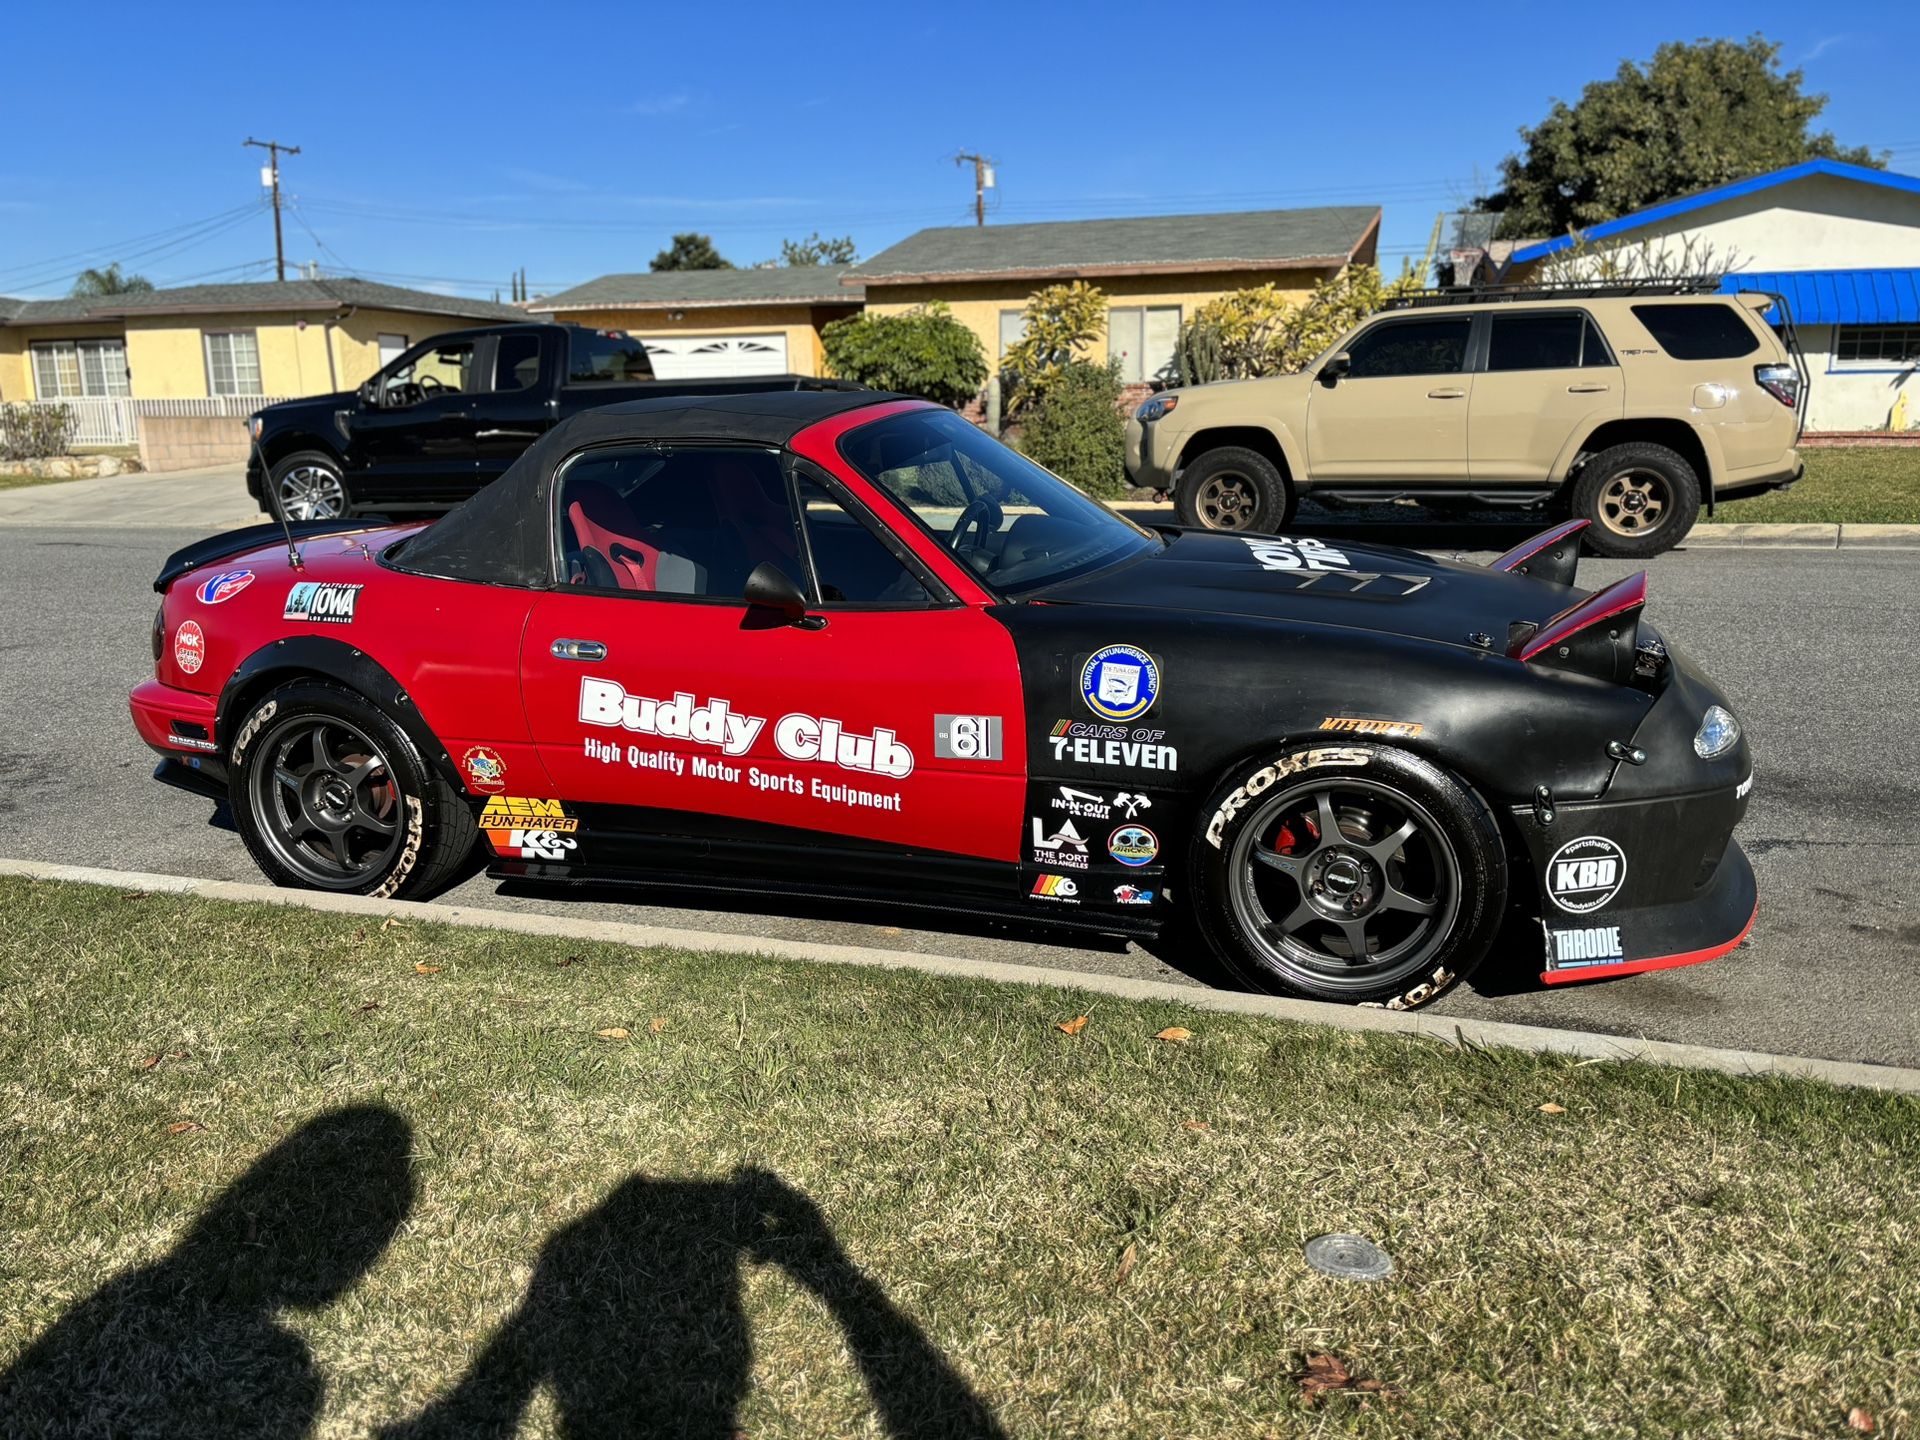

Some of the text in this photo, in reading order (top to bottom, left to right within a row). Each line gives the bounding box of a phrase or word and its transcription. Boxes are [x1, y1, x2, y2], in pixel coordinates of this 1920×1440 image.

[311, 587, 356, 616] IOWA
[180, 633, 199, 647] NGK
[180, 648, 198, 657] SPARK
[1084, 659, 1100, 690] CENTRAL
[1145, 664, 1157, 694] AGENCY
[232, 699, 277, 766] TOYO
[578, 675, 915, 779] Buddy Club
[1068, 722, 1166, 743] CARS OF
[584, 737, 902, 812] High Quality Motor Sports Equipment
[481, 795, 566, 818] AEM
[1205, 747, 1374, 849] PROXES
[480, 815, 575, 831] FUN-HAVER
[1032, 817, 1089, 853] LA
[366, 794, 423, 898] PROXE
[509, 829, 578, 860] K&N
[1034, 849, 1089, 864] THE PORT
[1564, 839, 1612, 855] #partsthatfit
[1044, 859, 1058, 867] LOS
[1057, 861, 1089, 870] ANGELES
[1556, 859, 1617, 891] KBD
[1559, 892, 1610, 911] kbdbodykits.com
